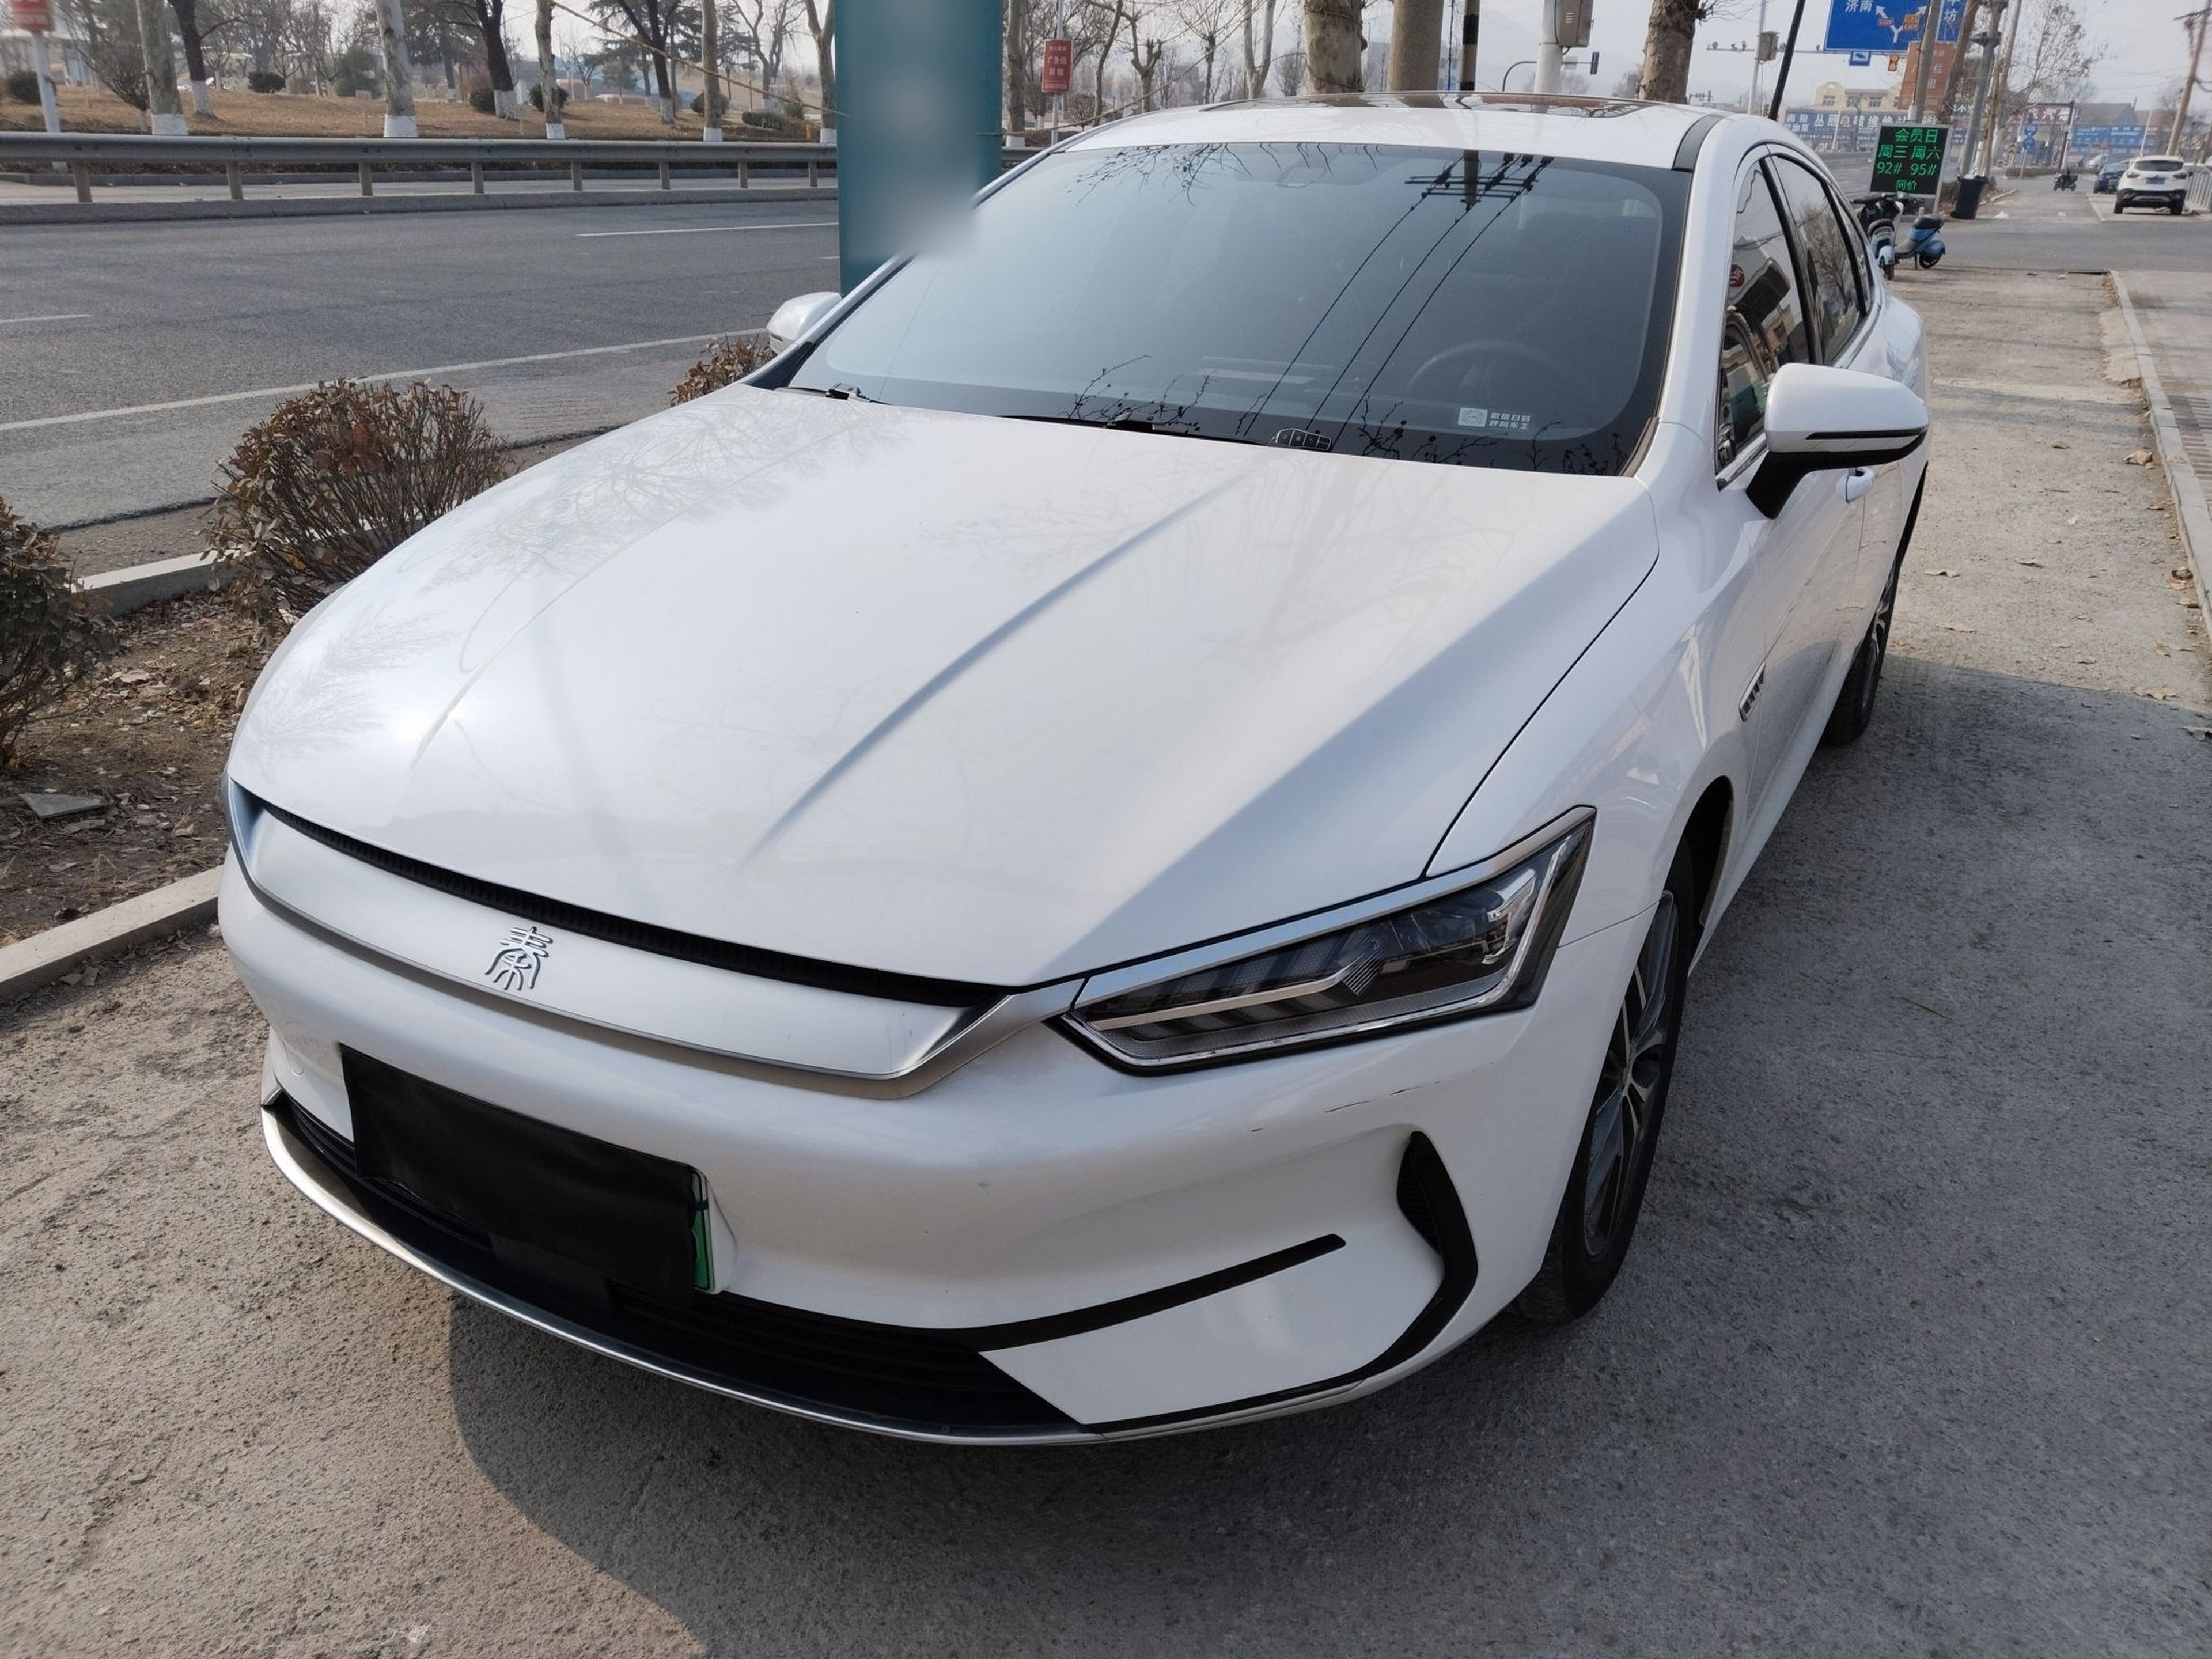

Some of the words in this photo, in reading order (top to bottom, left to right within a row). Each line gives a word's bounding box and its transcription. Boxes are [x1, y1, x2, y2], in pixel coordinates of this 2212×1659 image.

[1845, 0, 1873, 12] 济南
[1895, 128, 1938, 143] 会员日
[1878, 144, 1908, 158] 周三
[1911, 146, 1941, 161] 周六
[1877, 161, 1902, 175] 92#
[1910, 163, 1937, 176] 95#
[1896, 180, 1917, 191] 同价
